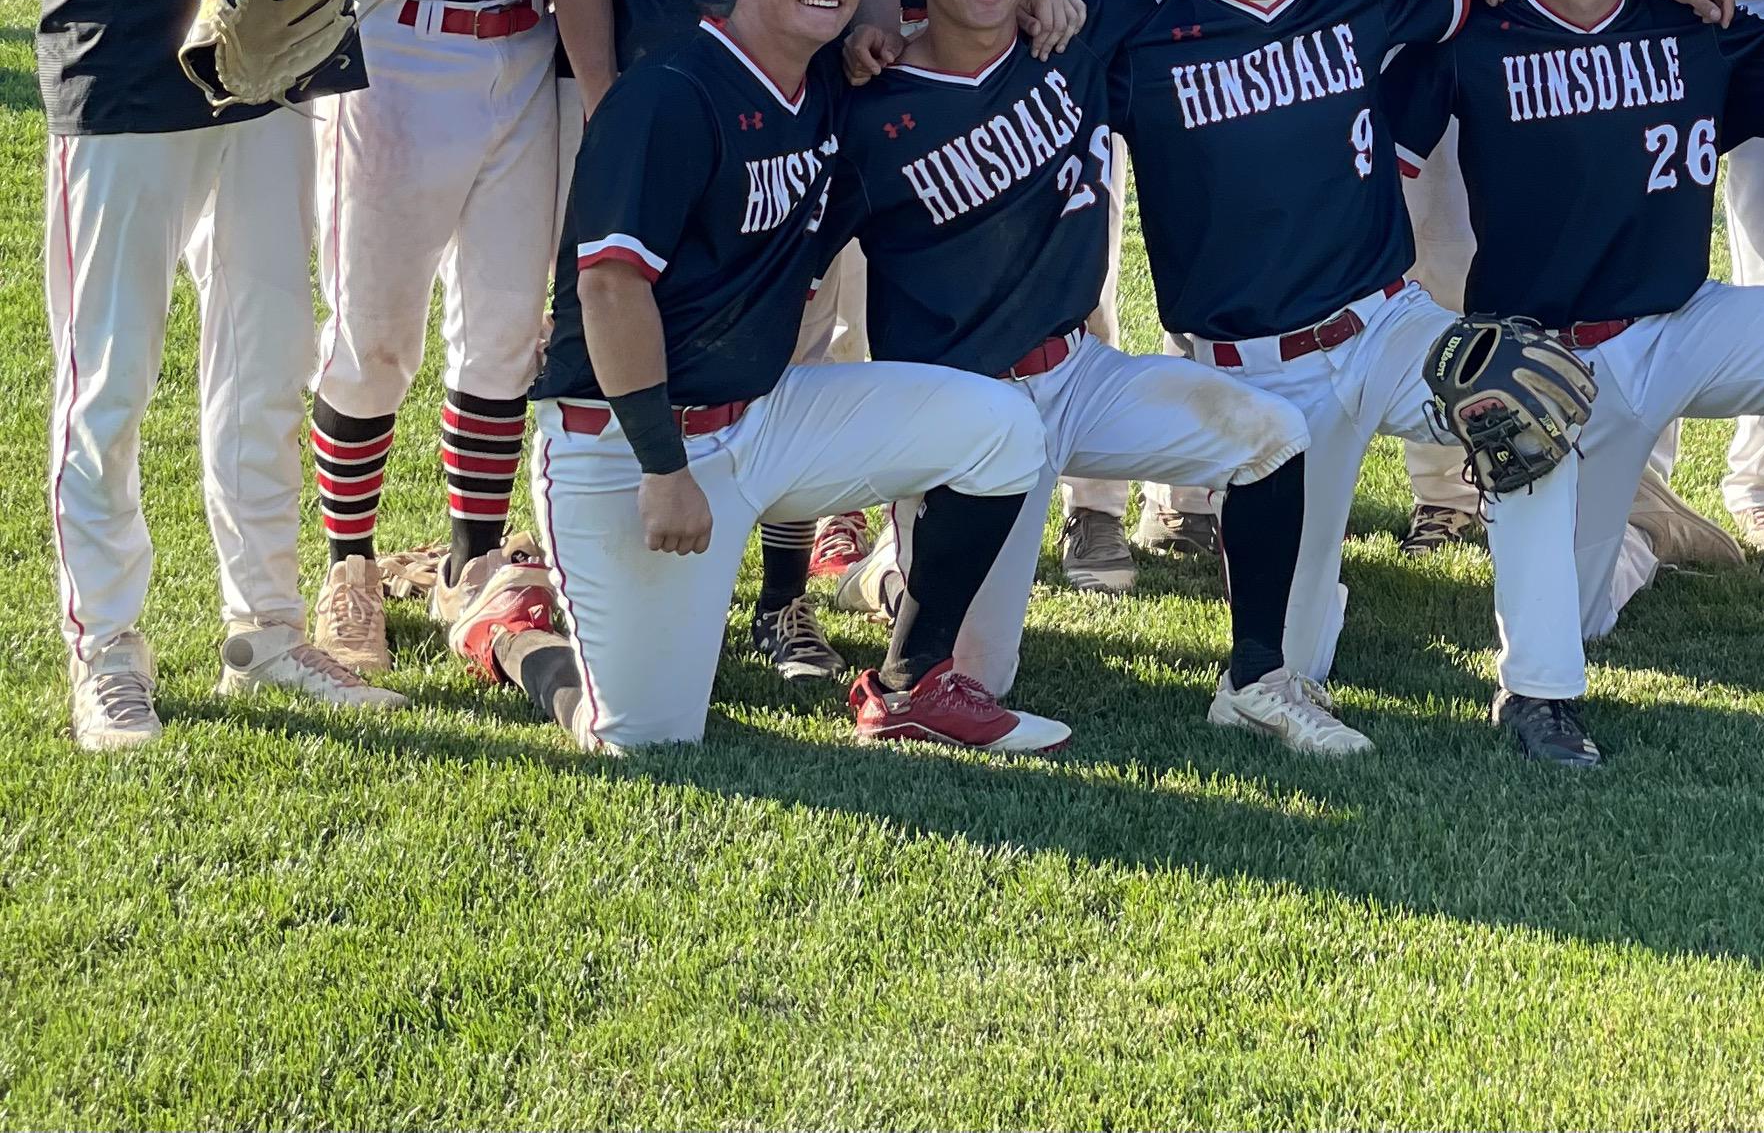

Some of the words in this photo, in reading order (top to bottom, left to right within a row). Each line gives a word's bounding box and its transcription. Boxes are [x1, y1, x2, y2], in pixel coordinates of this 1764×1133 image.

[1171, 21, 1366, 129] HINSDALE
[1502, 36, 1686, 122] HINSDALE
[902, 68, 1082, 225] HINSDALE
[1350, 107, 1374, 179] 9
[1645, 117, 1718, 193] 26
[1437, 336, 1462, 377] Wilson
